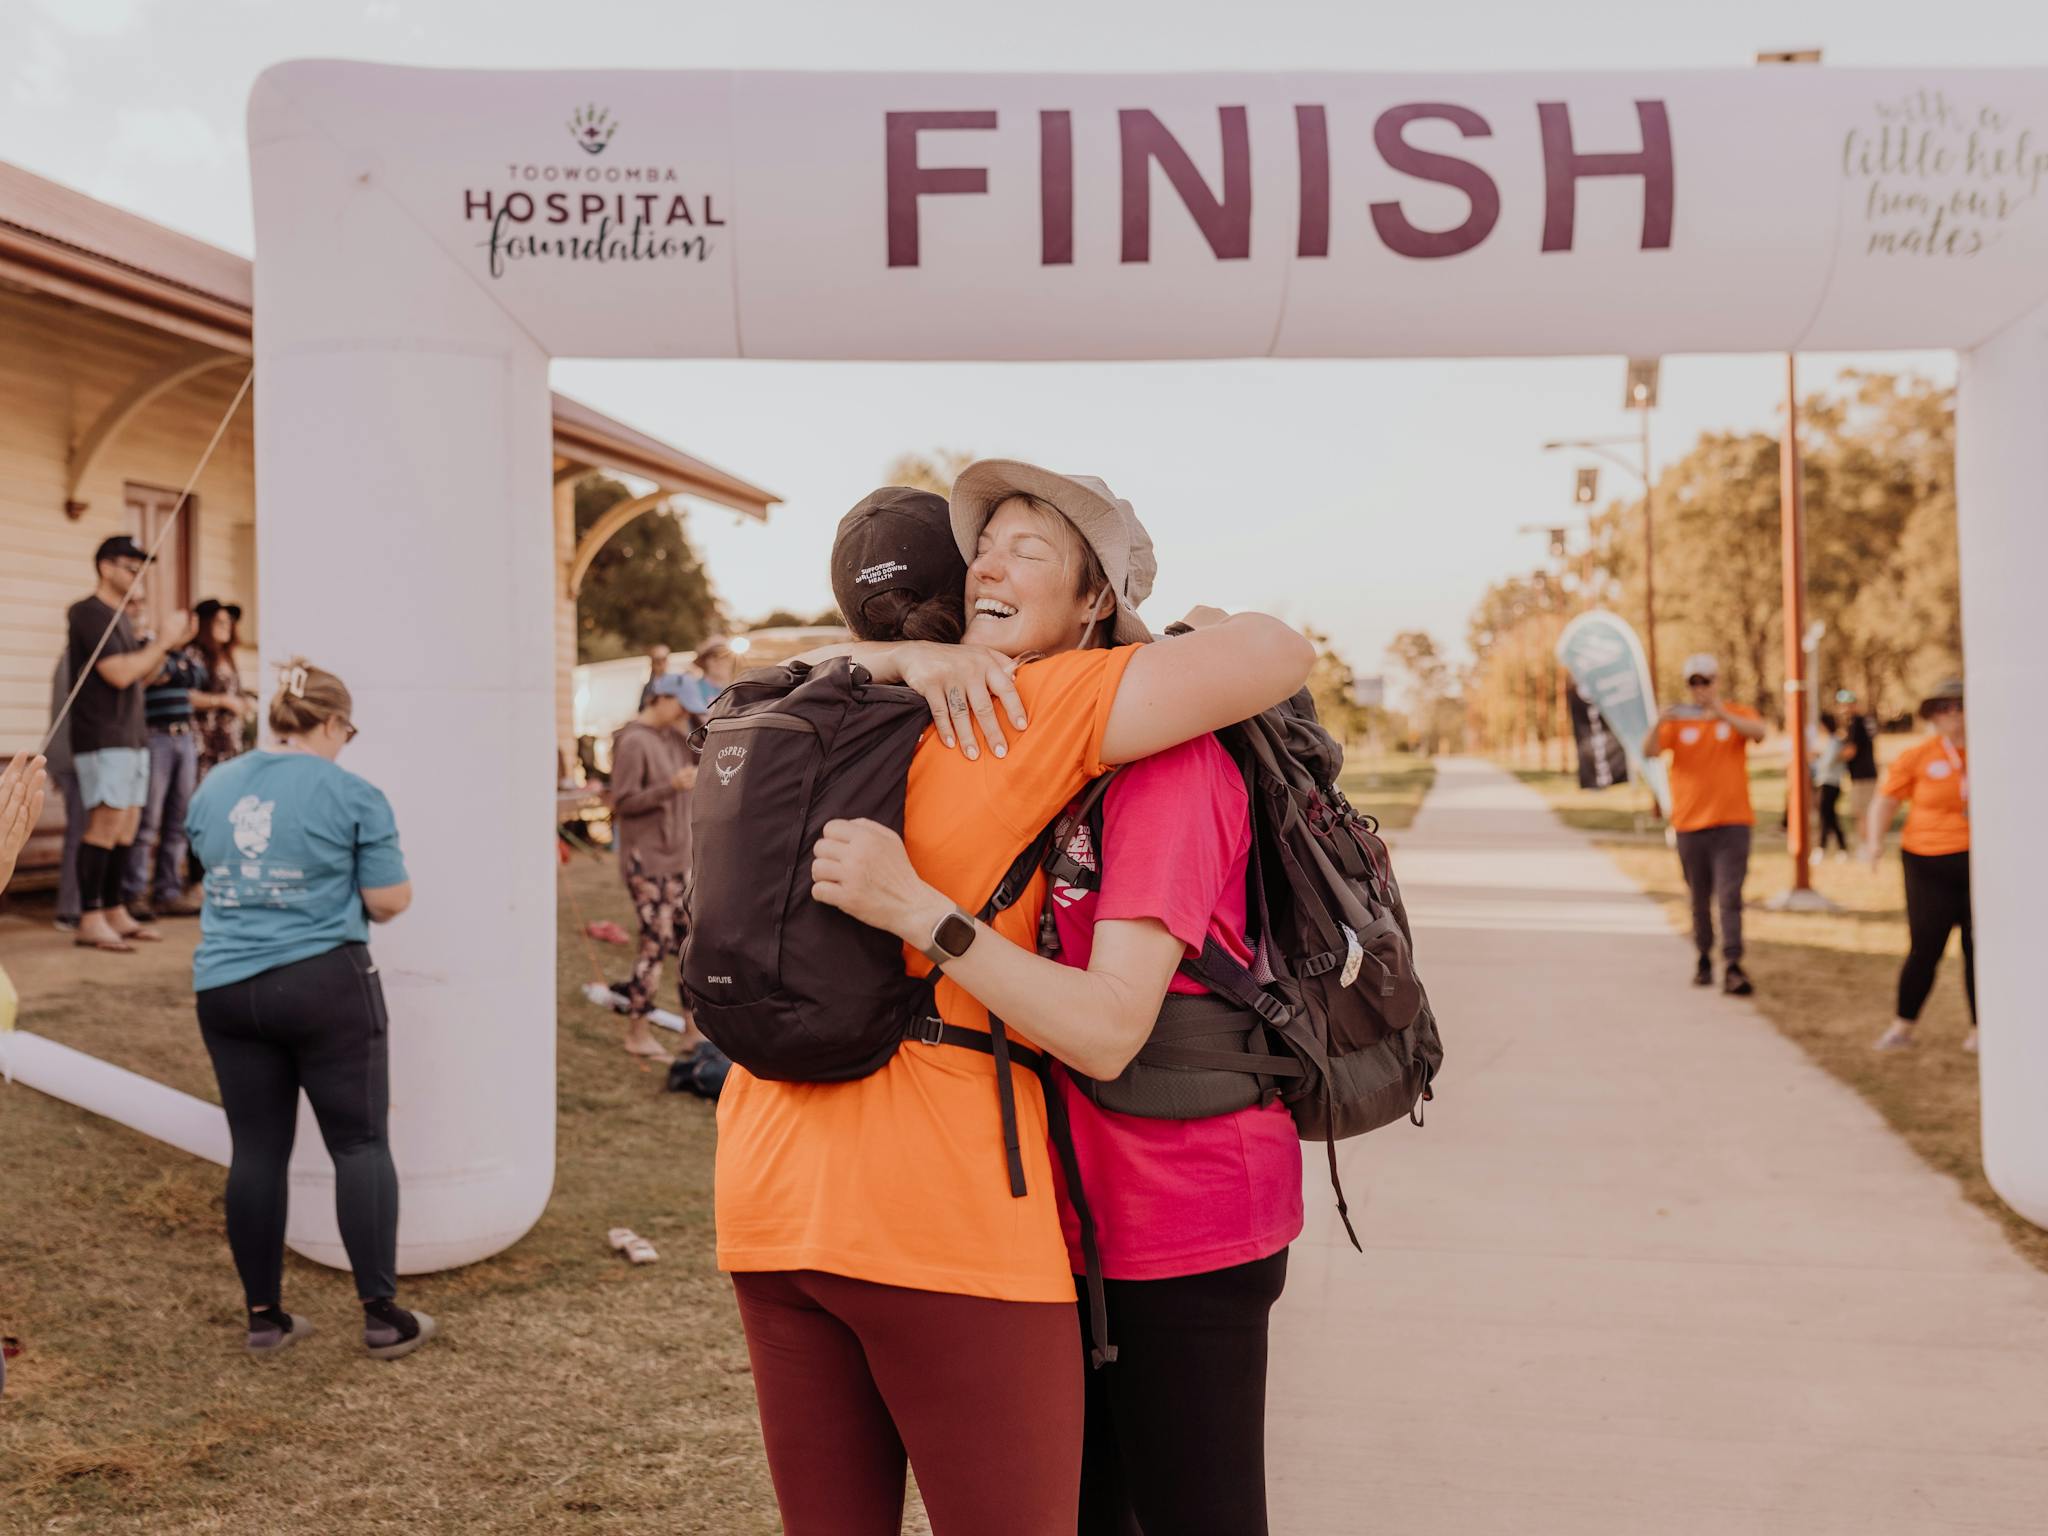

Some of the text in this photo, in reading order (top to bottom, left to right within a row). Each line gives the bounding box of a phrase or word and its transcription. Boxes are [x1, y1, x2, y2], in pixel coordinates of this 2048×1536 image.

[1875, 85, 1964, 133] with
[508, 164, 679, 183] TOOWOOMBA
[1841, 124, 2048, 197] little help
[885, 100, 1676, 268] FINISH
[463, 188, 726, 226] HOSPITAL
[476, 206, 714, 279] foundation
[1865, 204, 1984, 257] mates
[868, 573, 893, 584] HEALTH
[882, 565, 907, 574] DOWNS
[717, 746, 748, 759] OSPREY
[707, 975, 733, 984] DAYLITE
